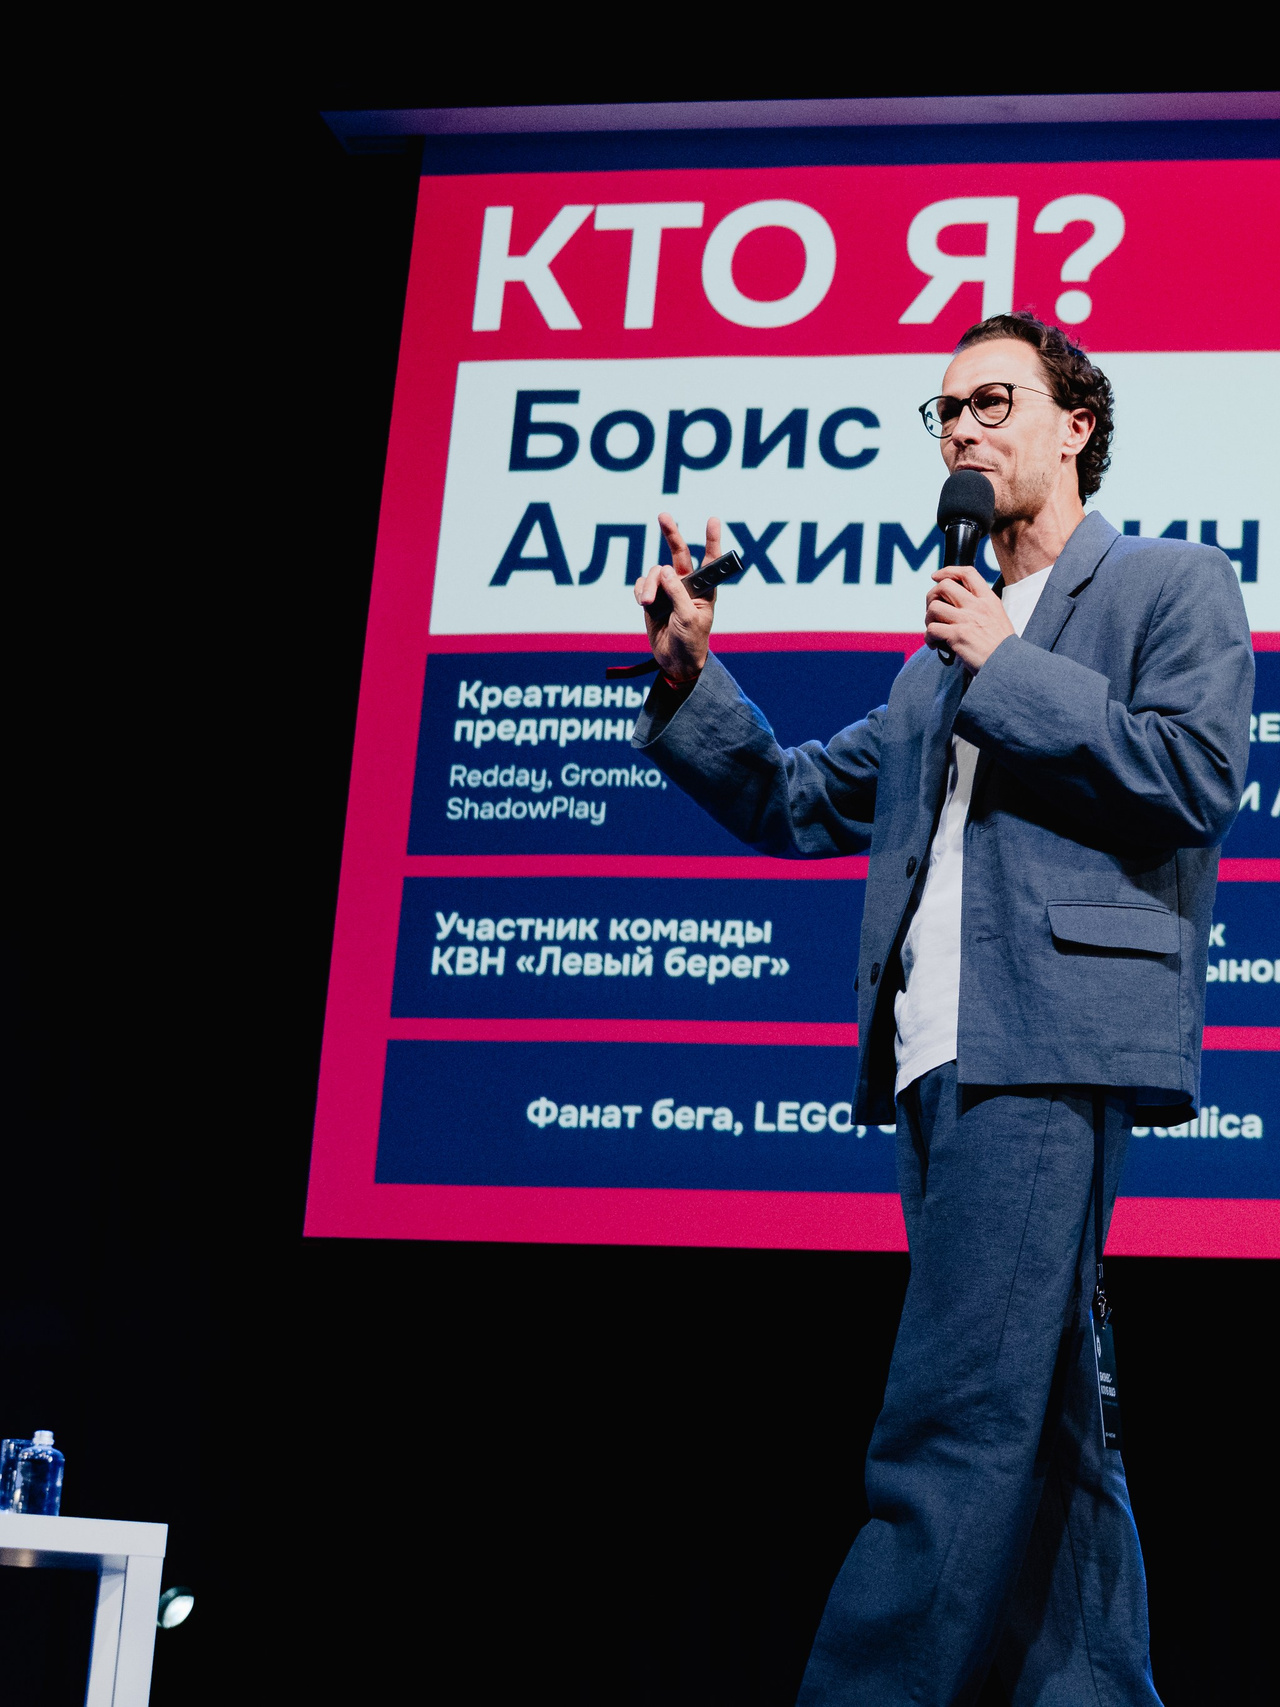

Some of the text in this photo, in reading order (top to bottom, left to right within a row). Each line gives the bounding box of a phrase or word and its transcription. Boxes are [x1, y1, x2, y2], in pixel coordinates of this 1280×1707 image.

[472, 195, 1126, 332] КТО Я?
[508, 389, 881, 494] Борис
[450, 763, 668, 793] Redday, Gromko,
[446, 796, 606, 826] ShadowPlay
[435, 911, 773, 949] Участник команды
[431, 945, 790, 986] КВН «Левый берег»
[526, 1097, 643, 1129] Фанат
[651, 1098, 744, 1137] бега,
